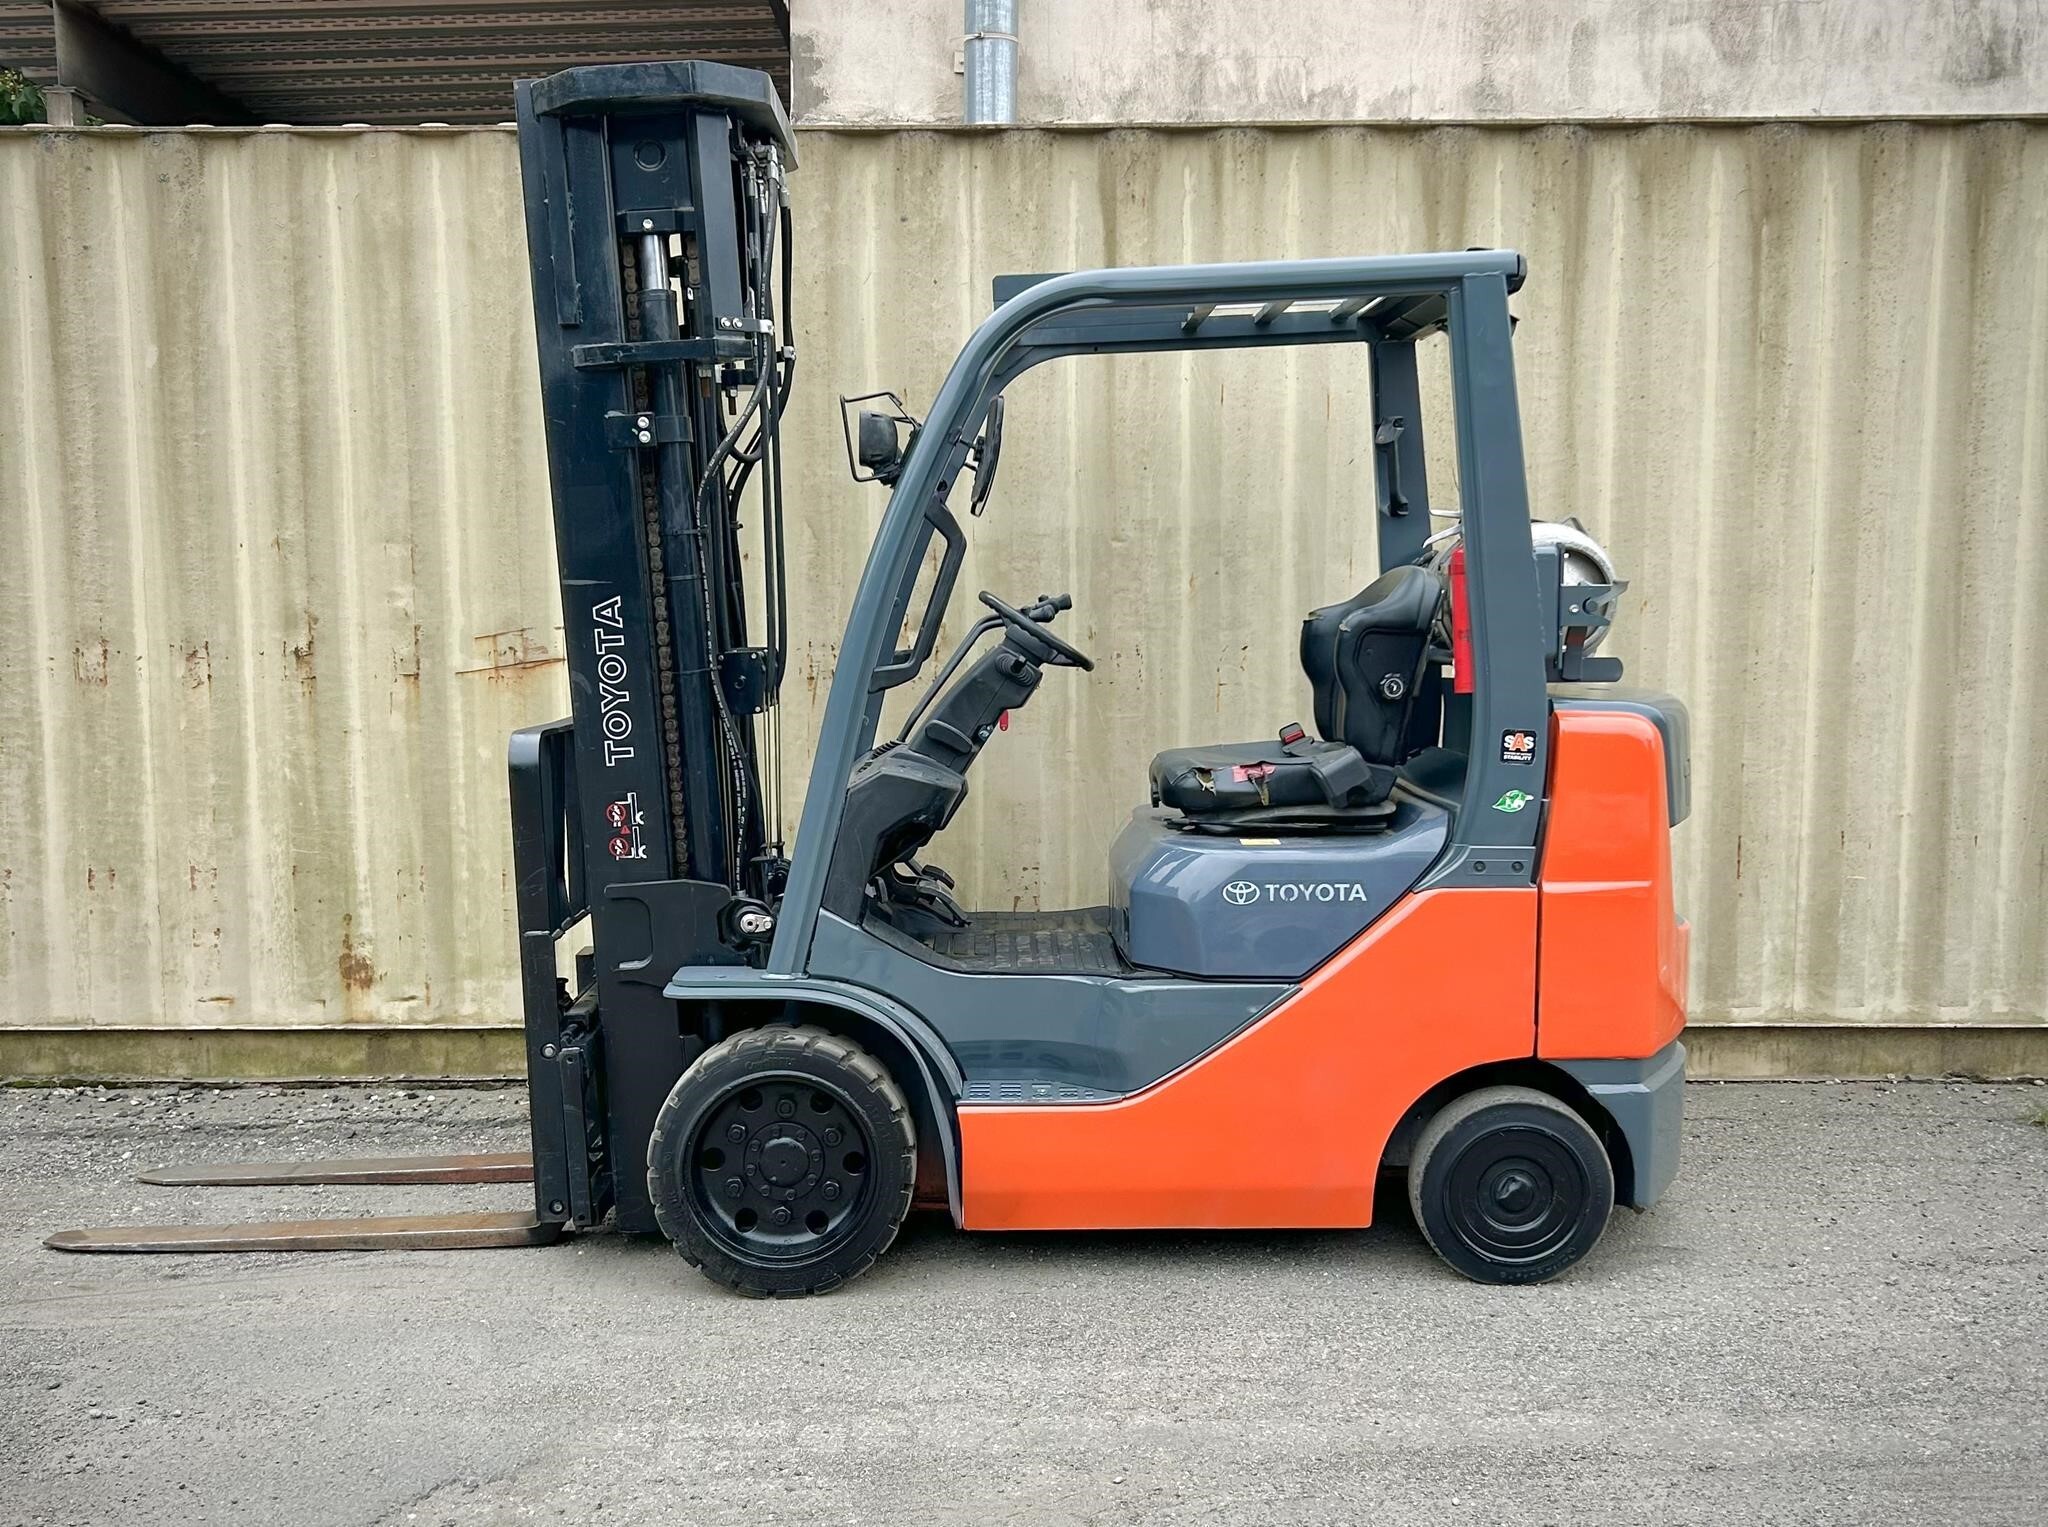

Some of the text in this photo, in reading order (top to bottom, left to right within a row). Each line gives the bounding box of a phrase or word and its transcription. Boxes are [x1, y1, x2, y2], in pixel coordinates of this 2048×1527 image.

[592, 595, 636, 767] TOYOTA
[1503, 733, 1534, 752] SAS
[1265, 883, 1368, 902] TOYOTA
